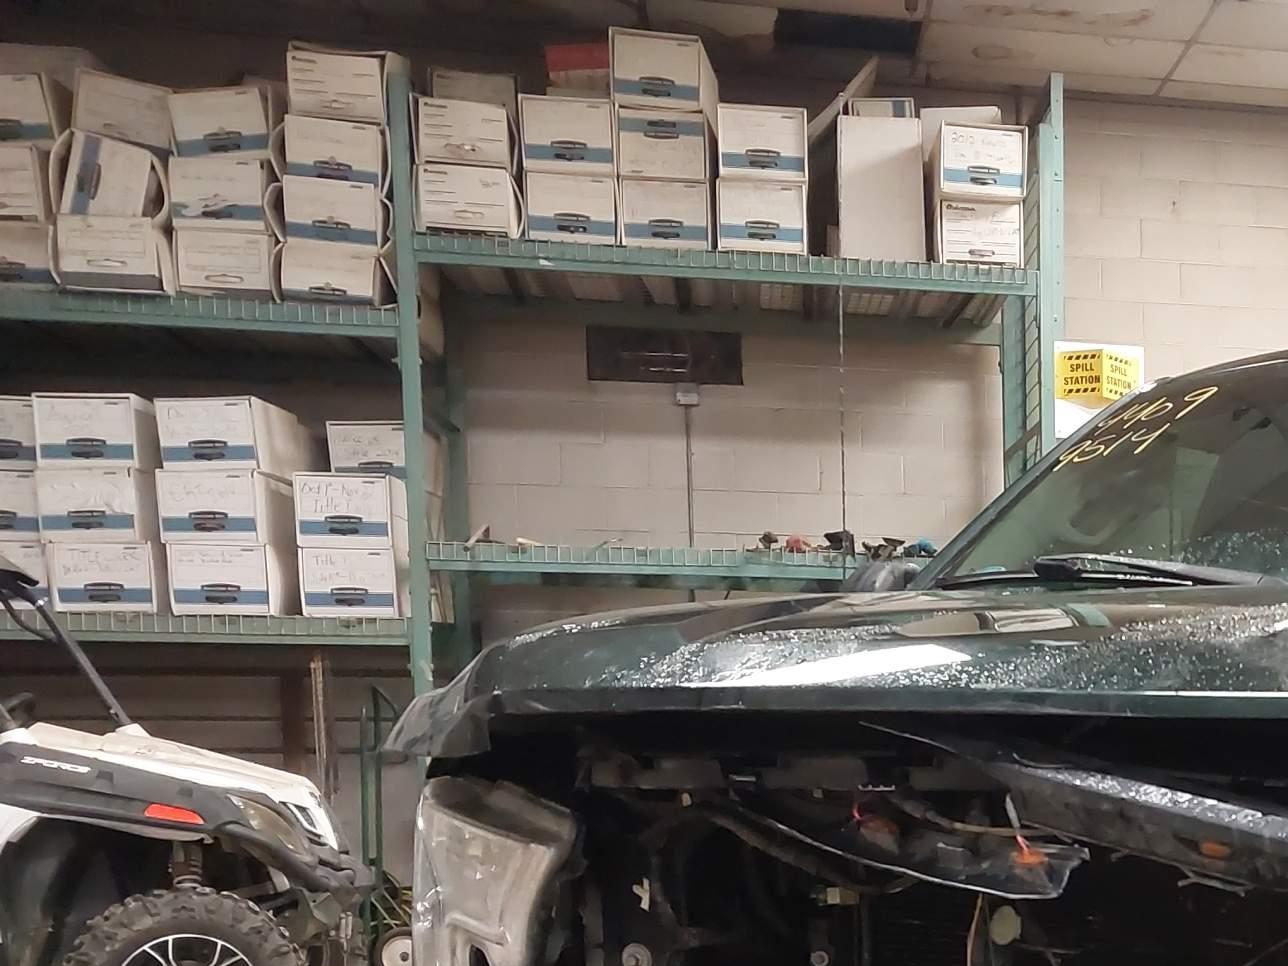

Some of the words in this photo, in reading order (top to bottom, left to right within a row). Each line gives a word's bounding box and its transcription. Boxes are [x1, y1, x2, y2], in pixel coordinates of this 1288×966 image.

[1069, 362, 1095, 373] SPILL
[1109, 363, 1128, 377] SPILL
[1063, 374, 1101, 386] STATION
[1106, 376, 1132, 390] STATION
[1052, 422, 1171, 472] 9514
